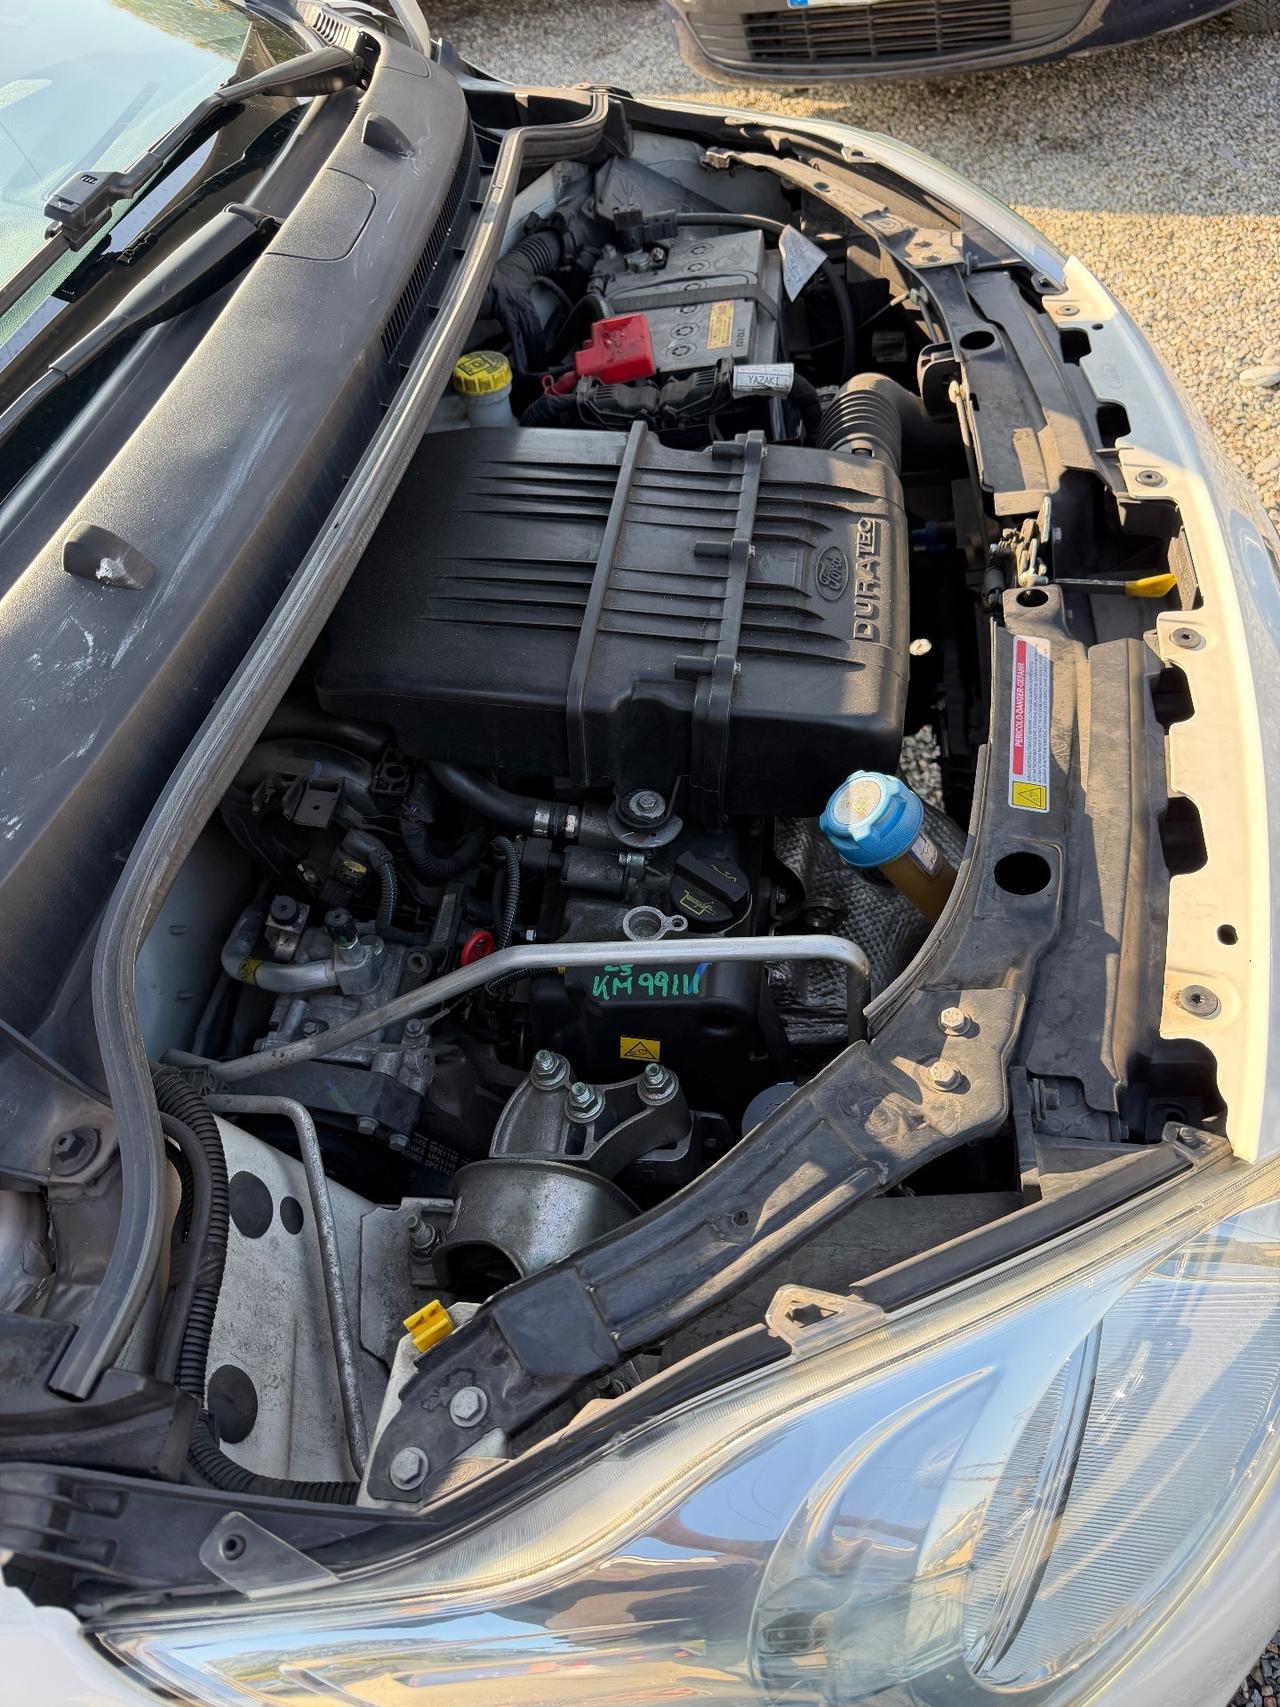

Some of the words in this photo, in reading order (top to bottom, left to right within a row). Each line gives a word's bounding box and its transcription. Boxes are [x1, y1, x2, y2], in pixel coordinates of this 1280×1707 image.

[748, 375, 780, 386] YAZAKI
[819, 556, 842, 591] Ford
[853, 517, 879, 640] DURATEC
